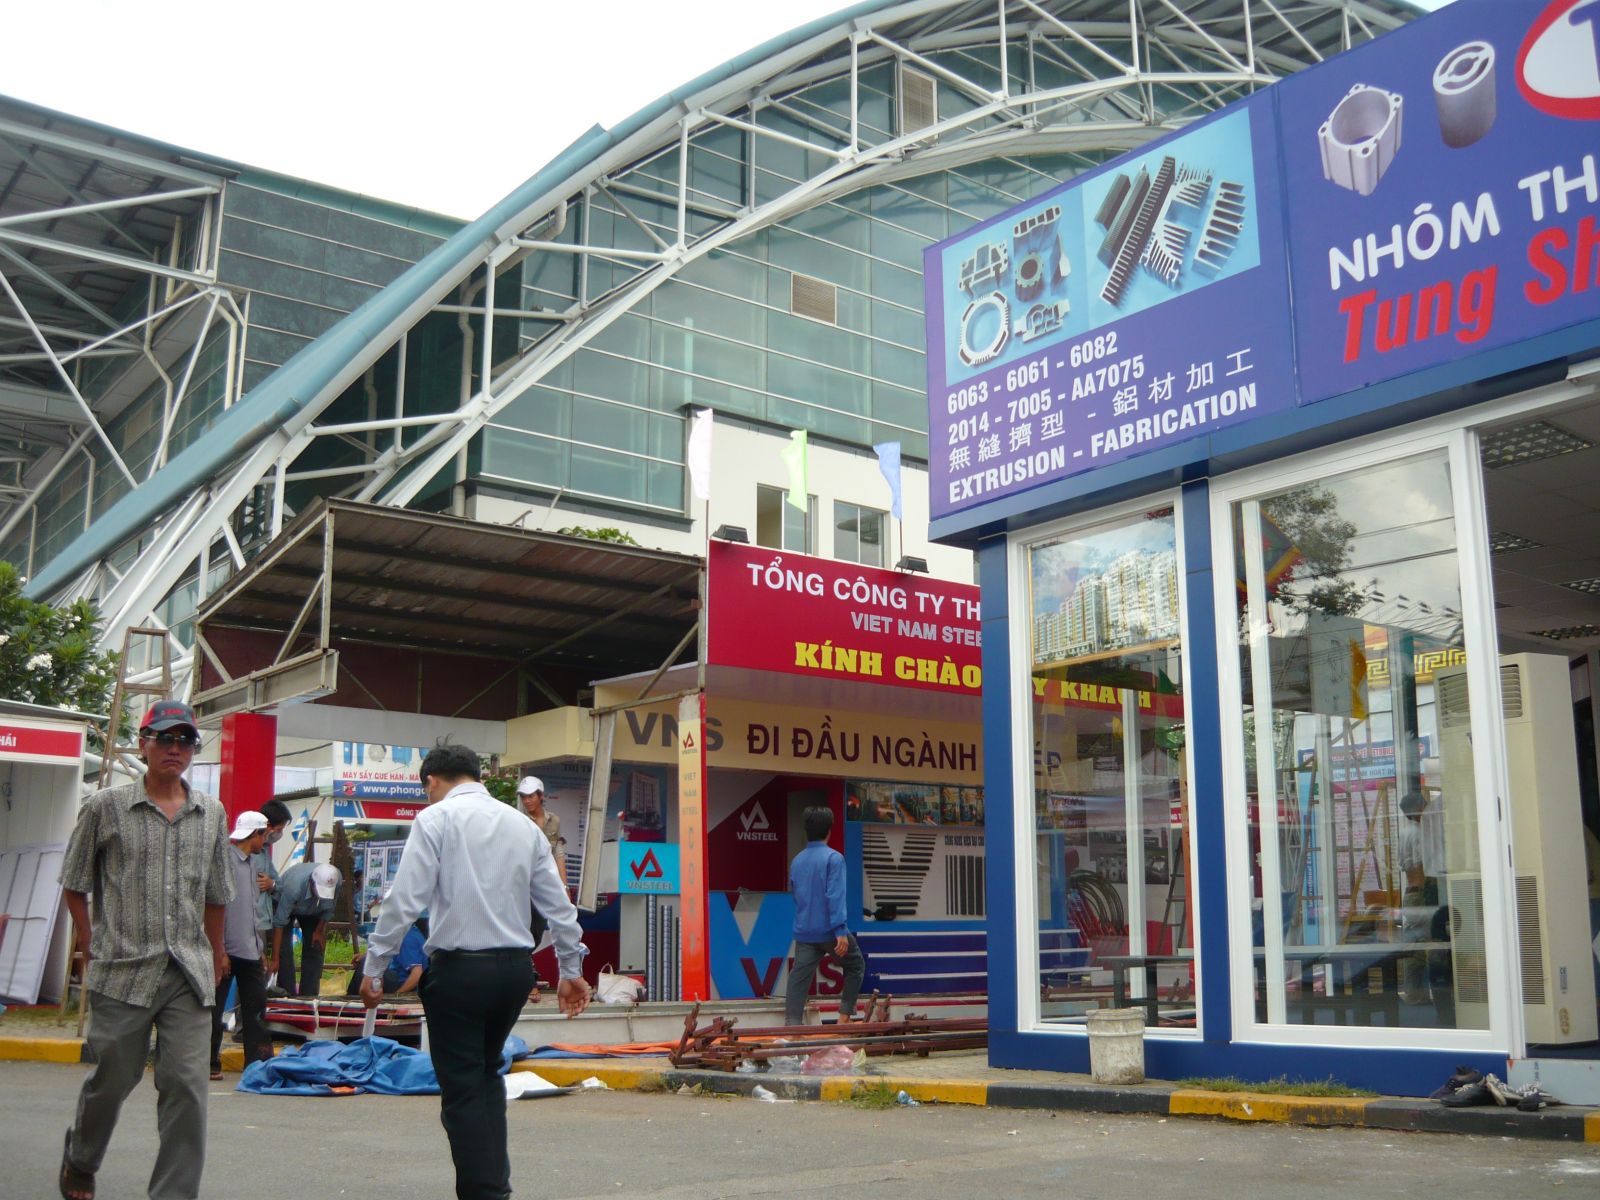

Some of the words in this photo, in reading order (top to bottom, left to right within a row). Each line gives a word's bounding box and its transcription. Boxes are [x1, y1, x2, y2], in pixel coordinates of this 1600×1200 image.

[1329, 192, 1501, 290] NHÔM
[1517, 155, 1599, 222] TH
[1338, 265, 1498, 364] Tung
[947, 381, 989, 415] 6063
[1006, 356, 1050, 392] 6061
[1070, 331, 1118, 367] 6082
[949, 413, 990, 446] 2014
[1007, 388, 1052, 423] 7005
[1071, 354, 1145, 402] AA7075
[949, 446, 1065, 504] EXTRUSION
[1091, 383, 1257, 458] FABRICATION
[746, 556, 824, 597] TỔNG
[833, 575, 907, 610] CÔNG
[914, 591, 945, 615] TY
[951, 598, 981, 621] TH
[850, 611, 893, 634] VIET
[897, 619, 937, 641] NAM
[794, 640, 883, 677] KÍNH
[894, 655, 982, 689] CHÀO
[747, 723, 780, 756] ĐI
[791, 715, 860, 763] ĐẦU
[872, 731, 977, 771] NGÀNH
[736, 831, 778, 841] VNSTEEL
[626, 880, 673, 890] VNSTEEL
